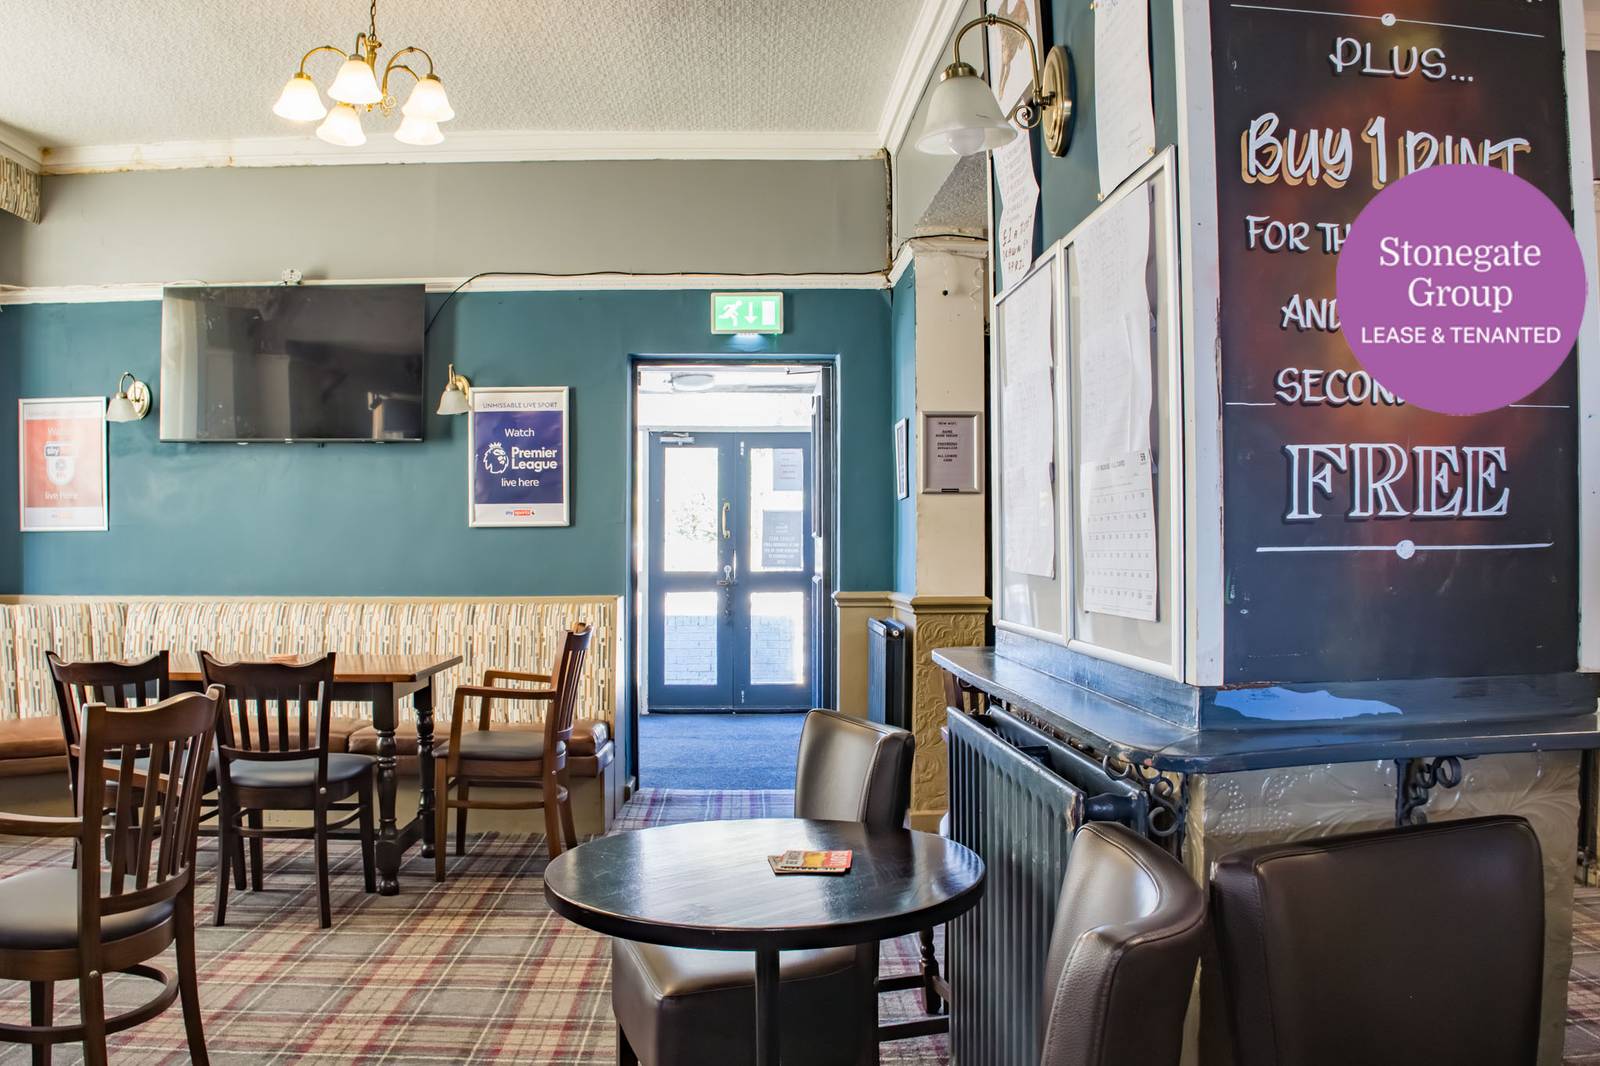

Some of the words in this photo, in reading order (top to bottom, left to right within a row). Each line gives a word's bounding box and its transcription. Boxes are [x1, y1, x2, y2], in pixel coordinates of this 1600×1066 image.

[1361, 116, 1388, 189] 1
[1245, 215, 1310, 252] FOR
[1316, 222, 1352, 253] TH
[1275, 366, 1405, 405] SECON
[482, 402, 522, 410] UNMISSABLE
[538, 401, 558, 409] SPORT
[504, 428, 535, 438] Watch
[511, 446, 558, 459] Premier
[511, 459, 558, 472] League
[501, 478, 517, 488] live
[518, 478, 540, 488] here
[1284, 442, 1511, 522] FREE
